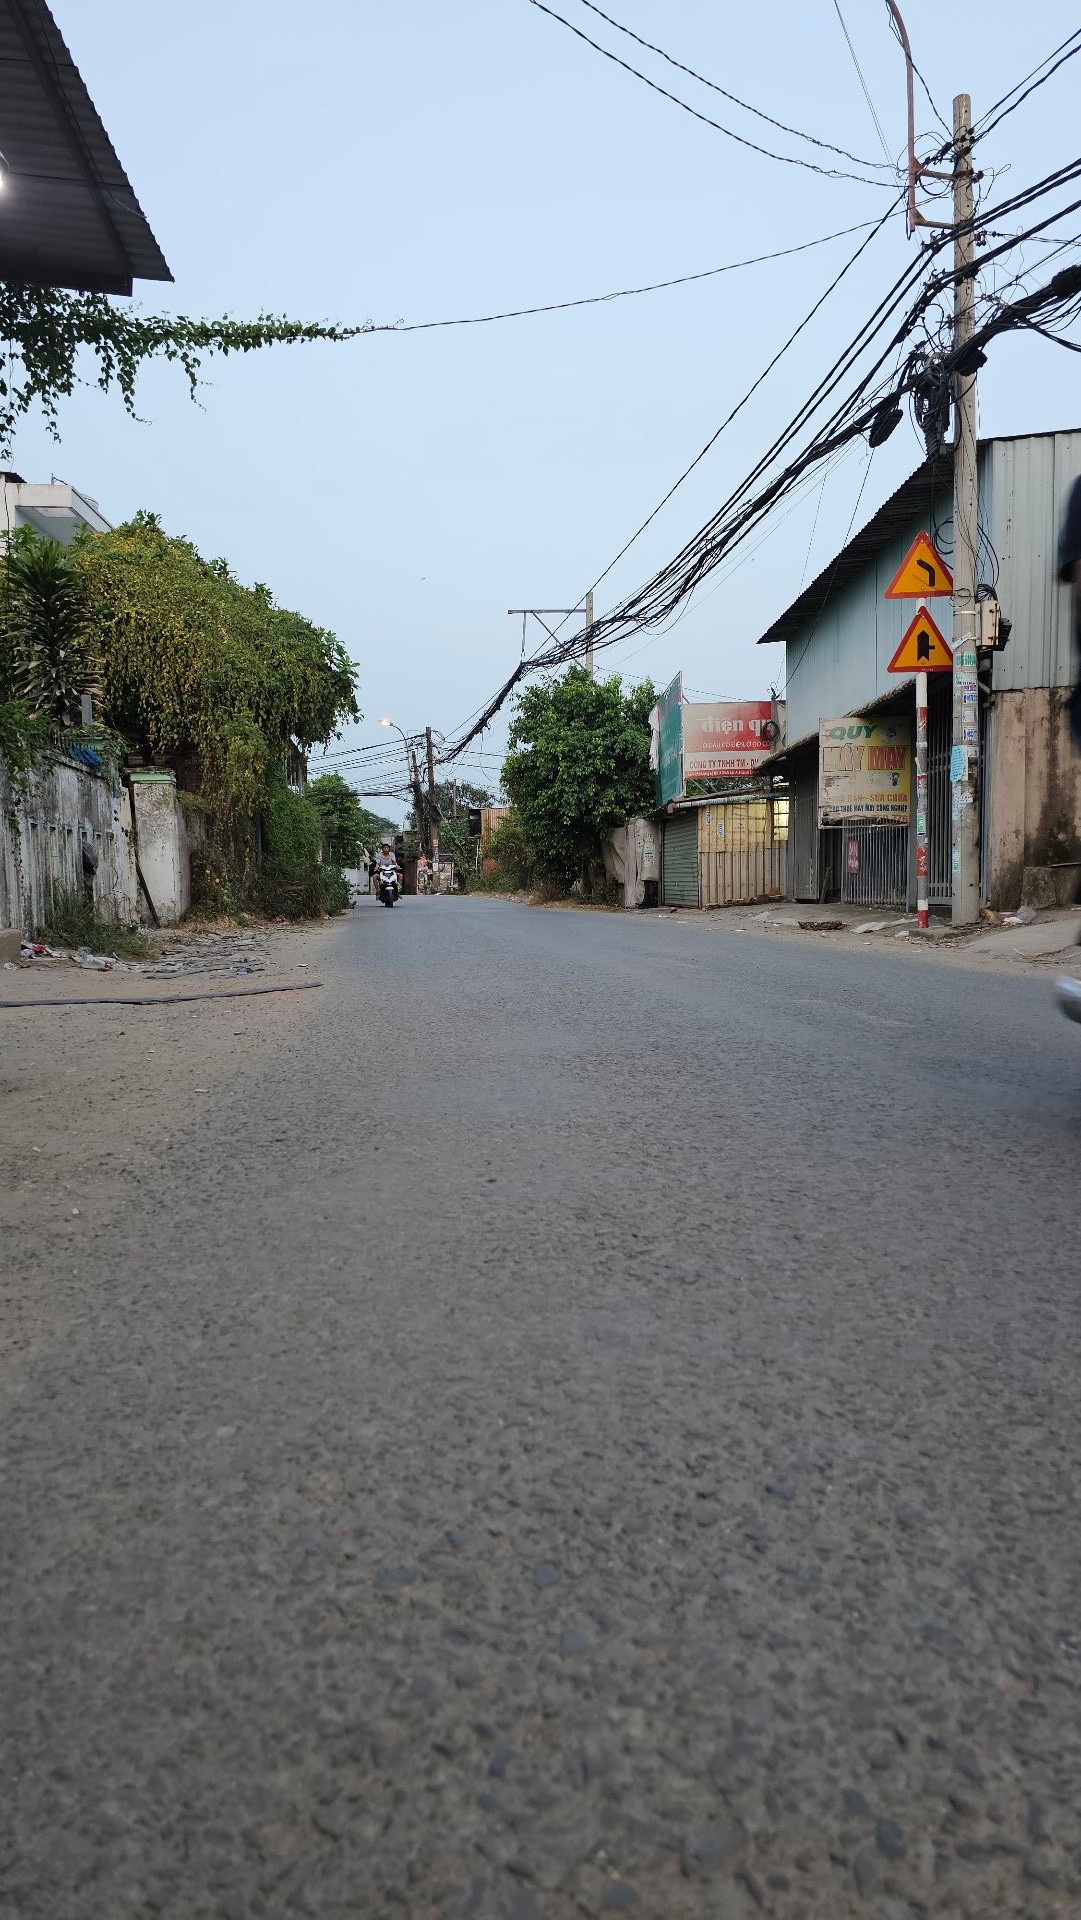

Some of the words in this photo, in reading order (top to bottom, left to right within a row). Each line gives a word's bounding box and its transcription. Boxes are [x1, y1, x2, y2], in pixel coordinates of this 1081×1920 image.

[708, 759, 717, 769] TY
[717, 759, 735, 768] TNHH
[736, 759, 746, 768] TM
